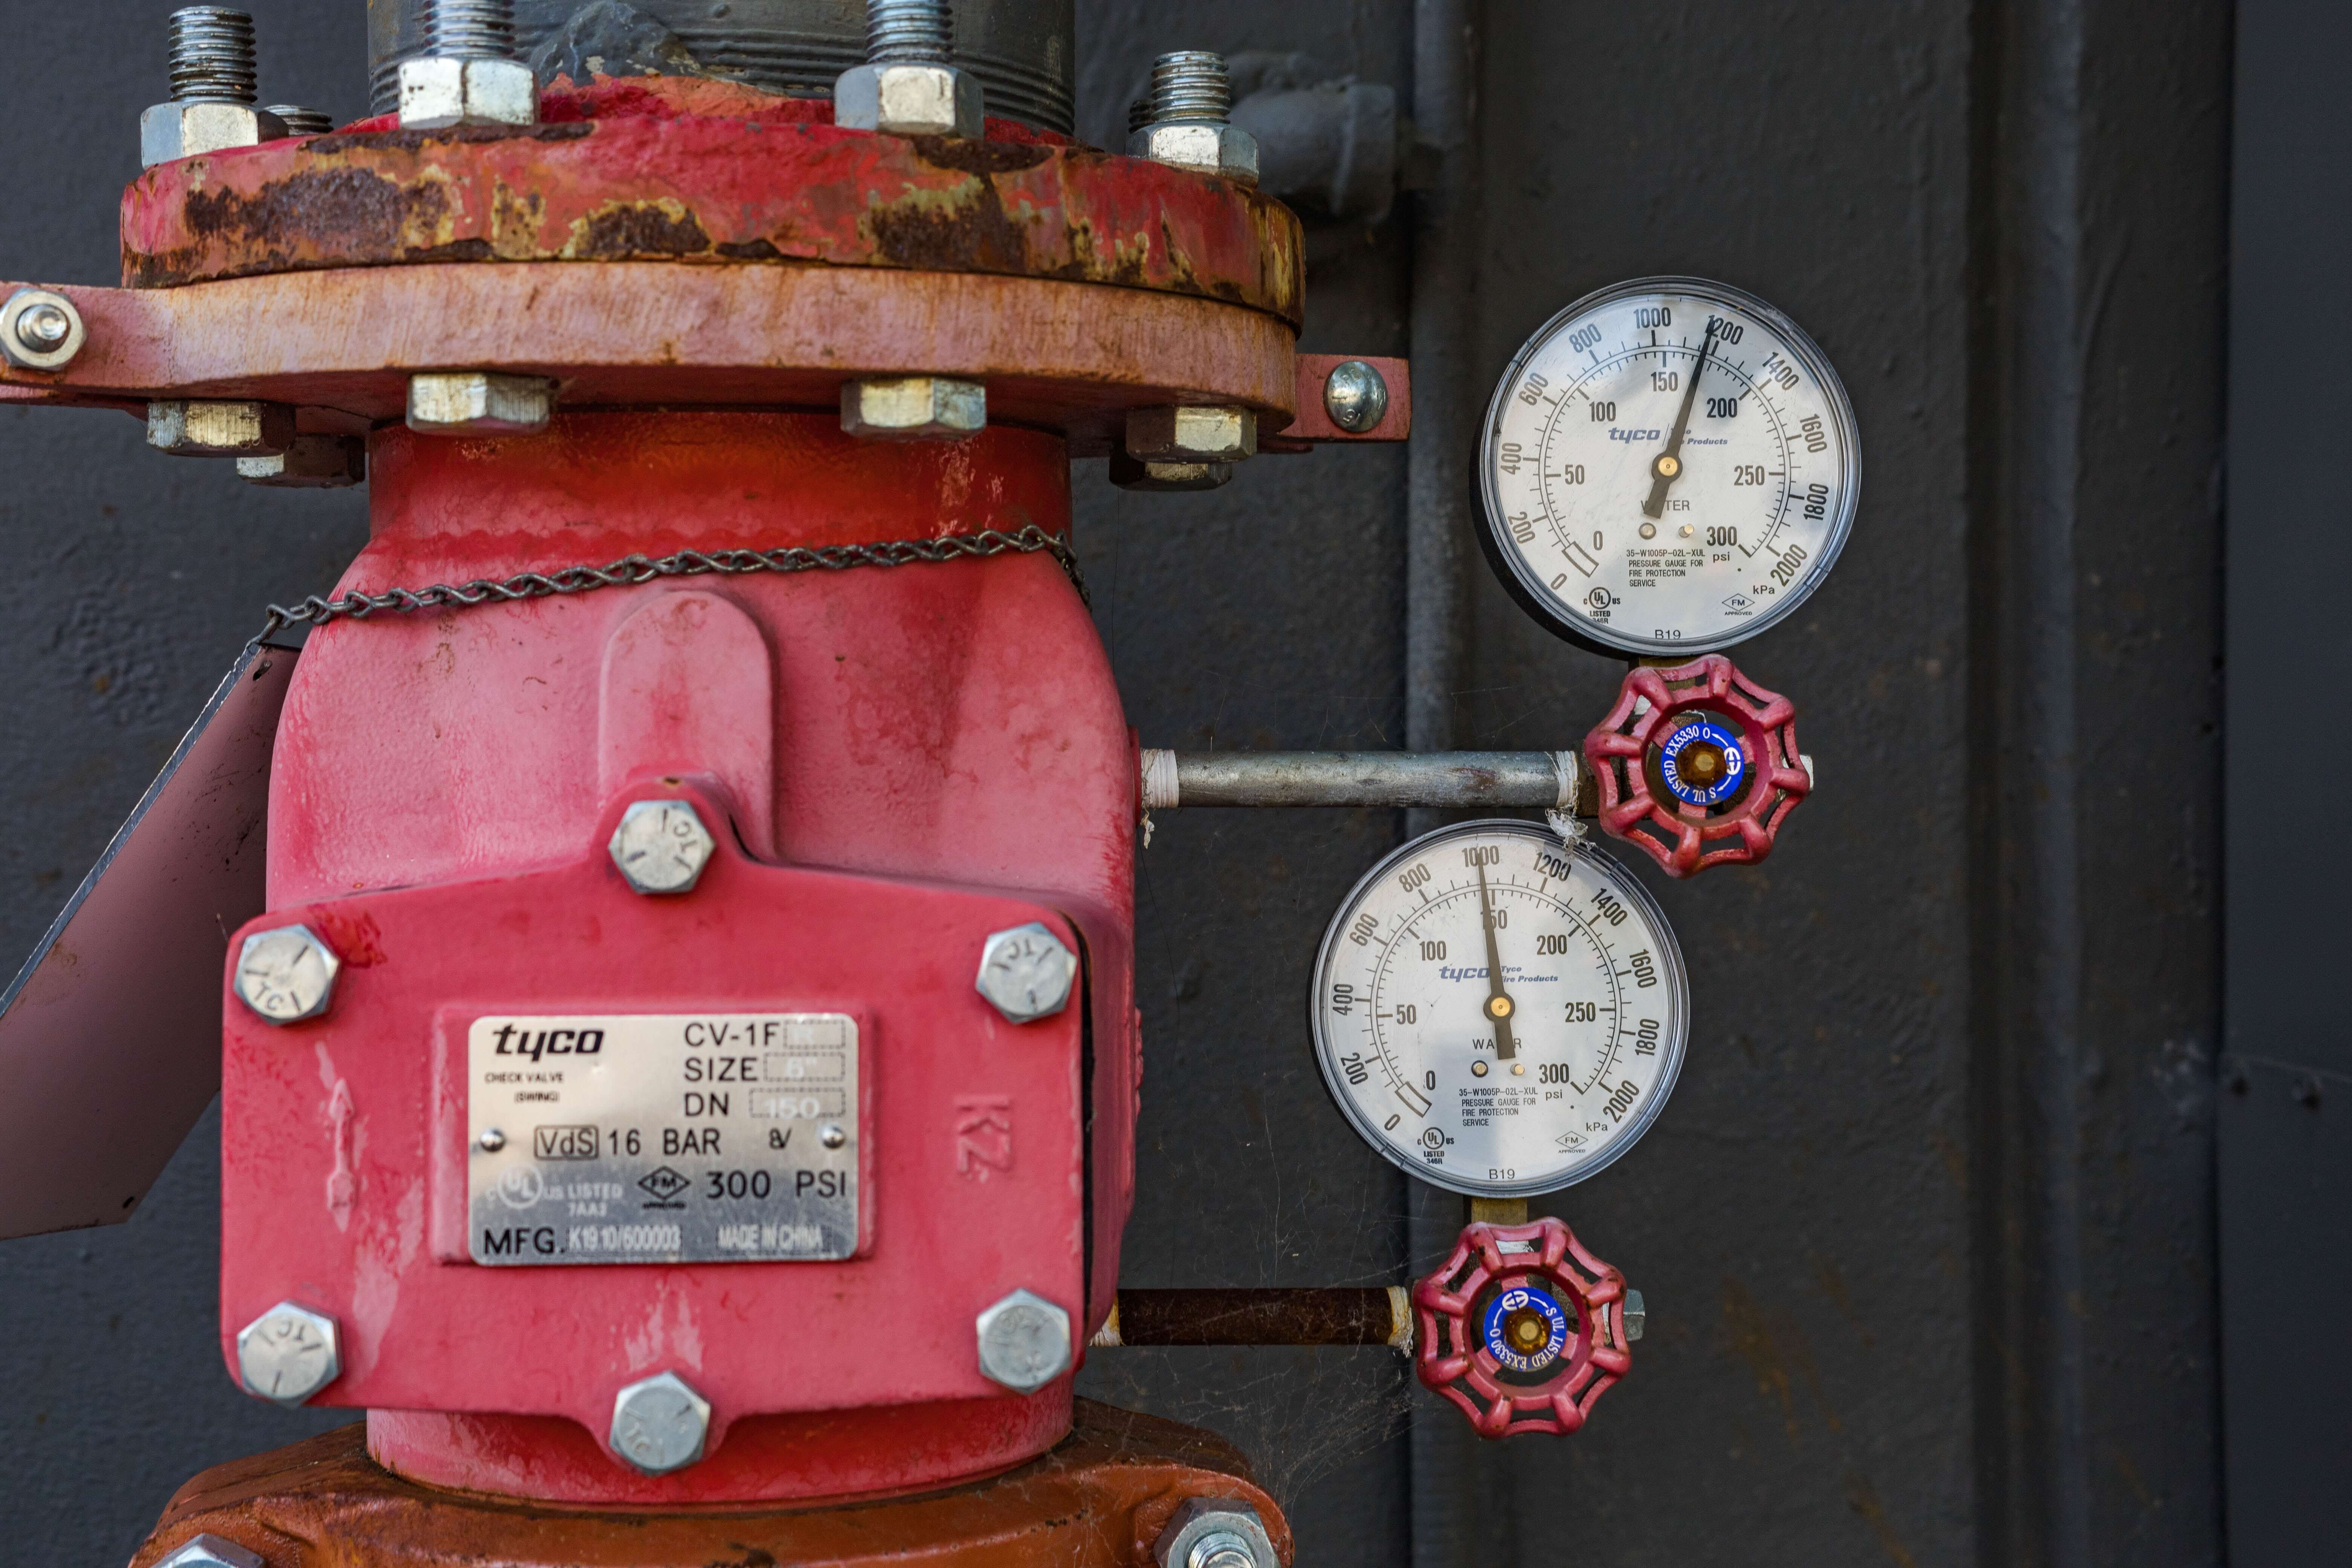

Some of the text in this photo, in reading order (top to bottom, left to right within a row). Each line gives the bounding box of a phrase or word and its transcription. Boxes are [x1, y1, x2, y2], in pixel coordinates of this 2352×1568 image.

[1633, 307, 1671, 329] 1000
[1568, 323, 1602, 353] 800
[1651, 372, 1678, 392] 150
[1762, 352, 1799, 391] 1400
[1518, 372, 1549, 406] 600
[1589, 401, 1616, 422] 100
[1706, 398, 1738, 418] 200
[1608, 427, 1661, 444] tyco
[1799, 413, 1828, 453] 1600
[1501, 442, 1522, 475] 400
[1565, 464, 1585, 485] 50
[1734, 465, 1765, 485] 250
[1803, 483, 1829, 521] 1800
[1508, 511, 1536, 544] 200
[1706, 526, 1737, 546] 300
[1593, 530, 1603, 550] 0
[1626, 549, 1706, 557] 35-W1005P-02L-XUL
[1712, 551, 1730, 563] psi
[1770, 544, 1808, 587] 2000
[1550, 573, 1567, 590] 0
[1753, 585, 1775, 595] kPa
[1594, 592, 1606, 605] UL
[1655, 629, 1681, 640] B19
[1666, 725, 1699, 757] EX5330
[1664, 760, 1690, 798] LISTED
[1693, 789, 1706, 802] UL
[1709, 787, 1716, 799] S
[1462, 845, 1500, 868] 1000
[1533, 852, 1572, 882] 1200
[1398, 863, 1431, 893] 800
[1591, 888, 1628, 926] 1400
[1349, 913, 1379, 946] 600
[1419, 940, 1446, 961] 100
[1536, 934, 1567, 955] 200
[1439, 966, 1490, 983] tyco
[1629, 949, 1657, 988] 1600
[1332, 984, 1354, 1016] 400
[1396, 1004, 1416, 1025] 50
[1565, 1001, 1596, 1023] 250
[492, 1022, 605, 1063] tyco
[1473, 1038, 1522, 1050] WAR
[1635, 1018, 1660, 1056] 1800
[485, 1072, 563, 1083] CHECK VALVE
[684, 1057, 759, 1082] SIZE
[1341, 1052, 1368, 1085] 200
[1539, 1063, 1570, 1084] 300
[1426, 1070, 1436, 1090] 0
[1459, 1087, 1538, 1096] 35-W1005P-02L-XUL
[1545, 1089, 1562, 1101] psi
[1603, 1080, 1640, 1123] 2000
[684, 1092, 821, 1120] DN 150
[1479, 1108, 1519, 1116] PROTECTION
[1384, 1114, 1401, 1131] 0
[1586, 1122, 1608, 1132] kPa
[539, 1129, 595, 1156] VdS
[608, 1128, 641, 1156] 16
[663, 1128, 721, 1156] BAR
[1428, 1132, 1439, 1145] UL
[706, 1169, 846, 1199] 300 PSI
[1489, 1168, 1515, 1179] B19
[567, 1183, 623, 1200] LISTED
[484, 1227, 565, 1255] MFG.
[718, 1223, 759, 1250] MADE
[761, 1223, 778, 1250] IN
[779, 1223, 823, 1250] CHINA
[1545, 1307, 1557, 1317] S
[1552, 1316, 1564, 1332] UL
[1491, 1339, 1527, 1369] EX5330
[1531, 1335, 1563, 1367] LISTED
